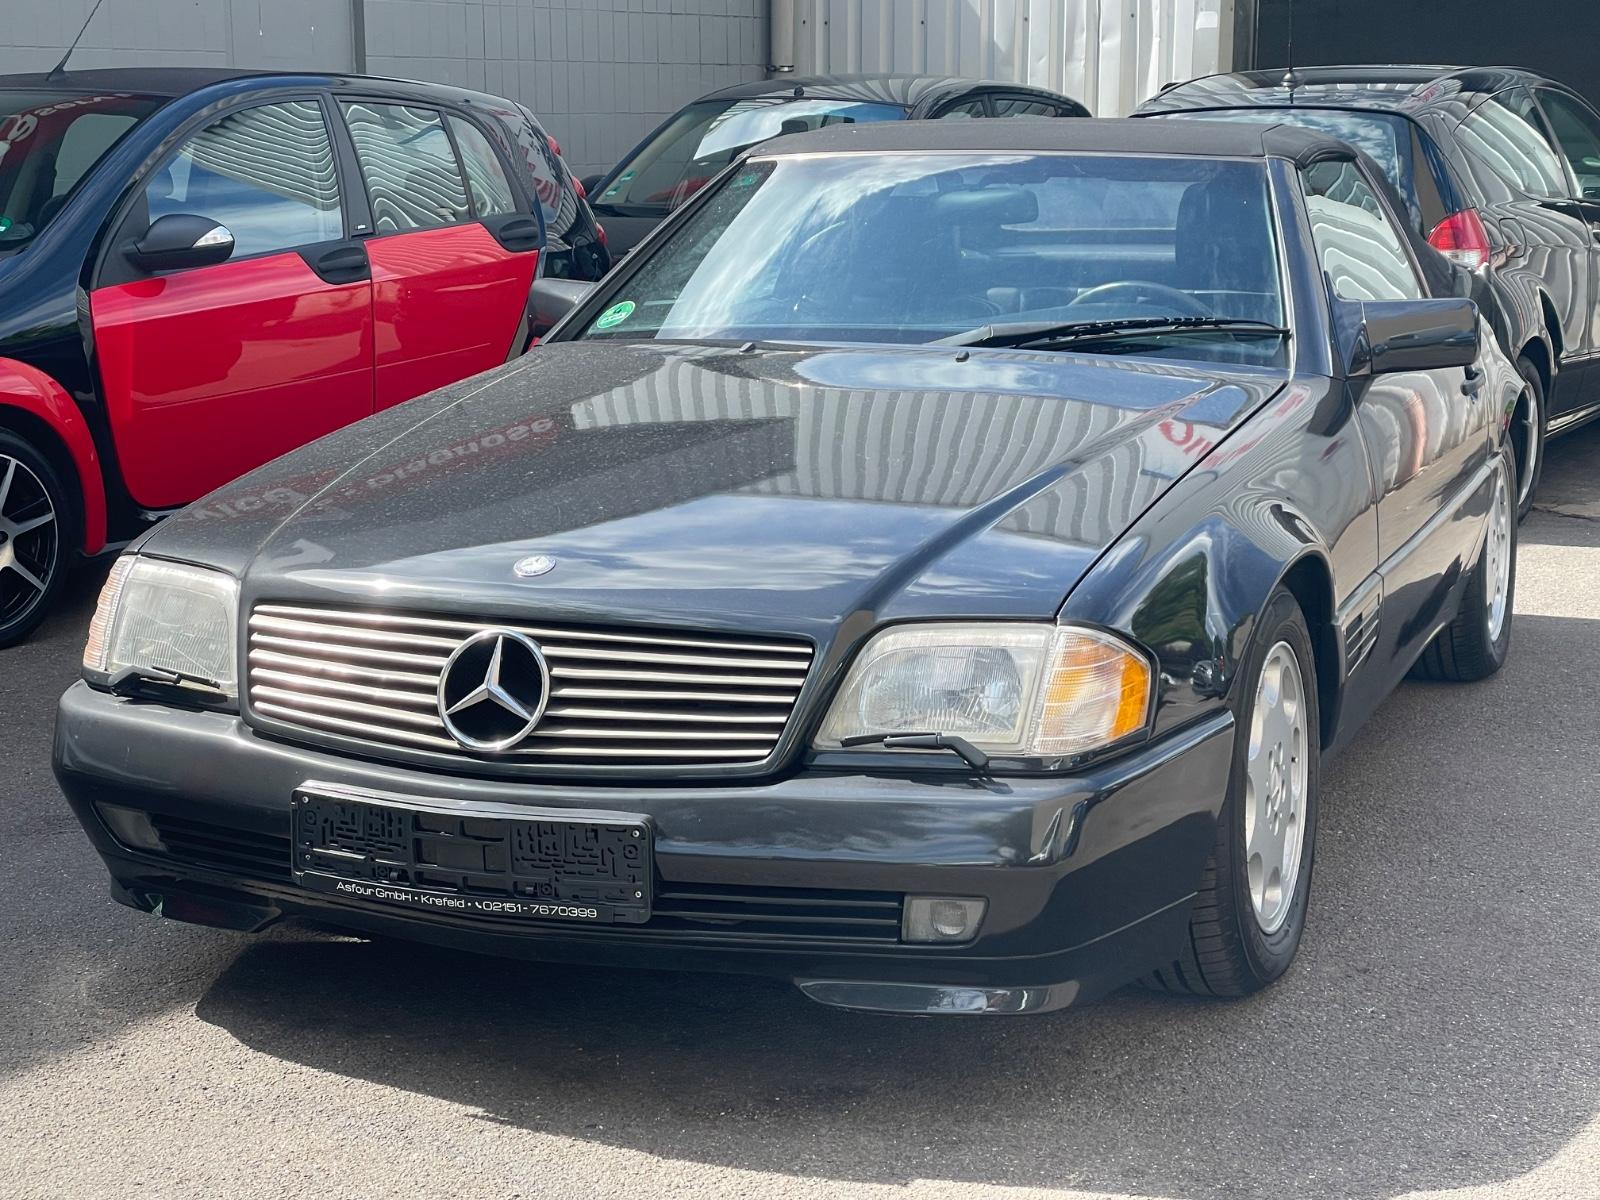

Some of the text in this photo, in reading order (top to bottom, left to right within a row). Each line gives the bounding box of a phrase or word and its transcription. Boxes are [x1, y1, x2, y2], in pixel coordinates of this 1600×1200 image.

[336, 881, 374, 895] Asfour
[375, 888, 412, 902] GmbH
[420, 894, 465, 908] Krefeld
